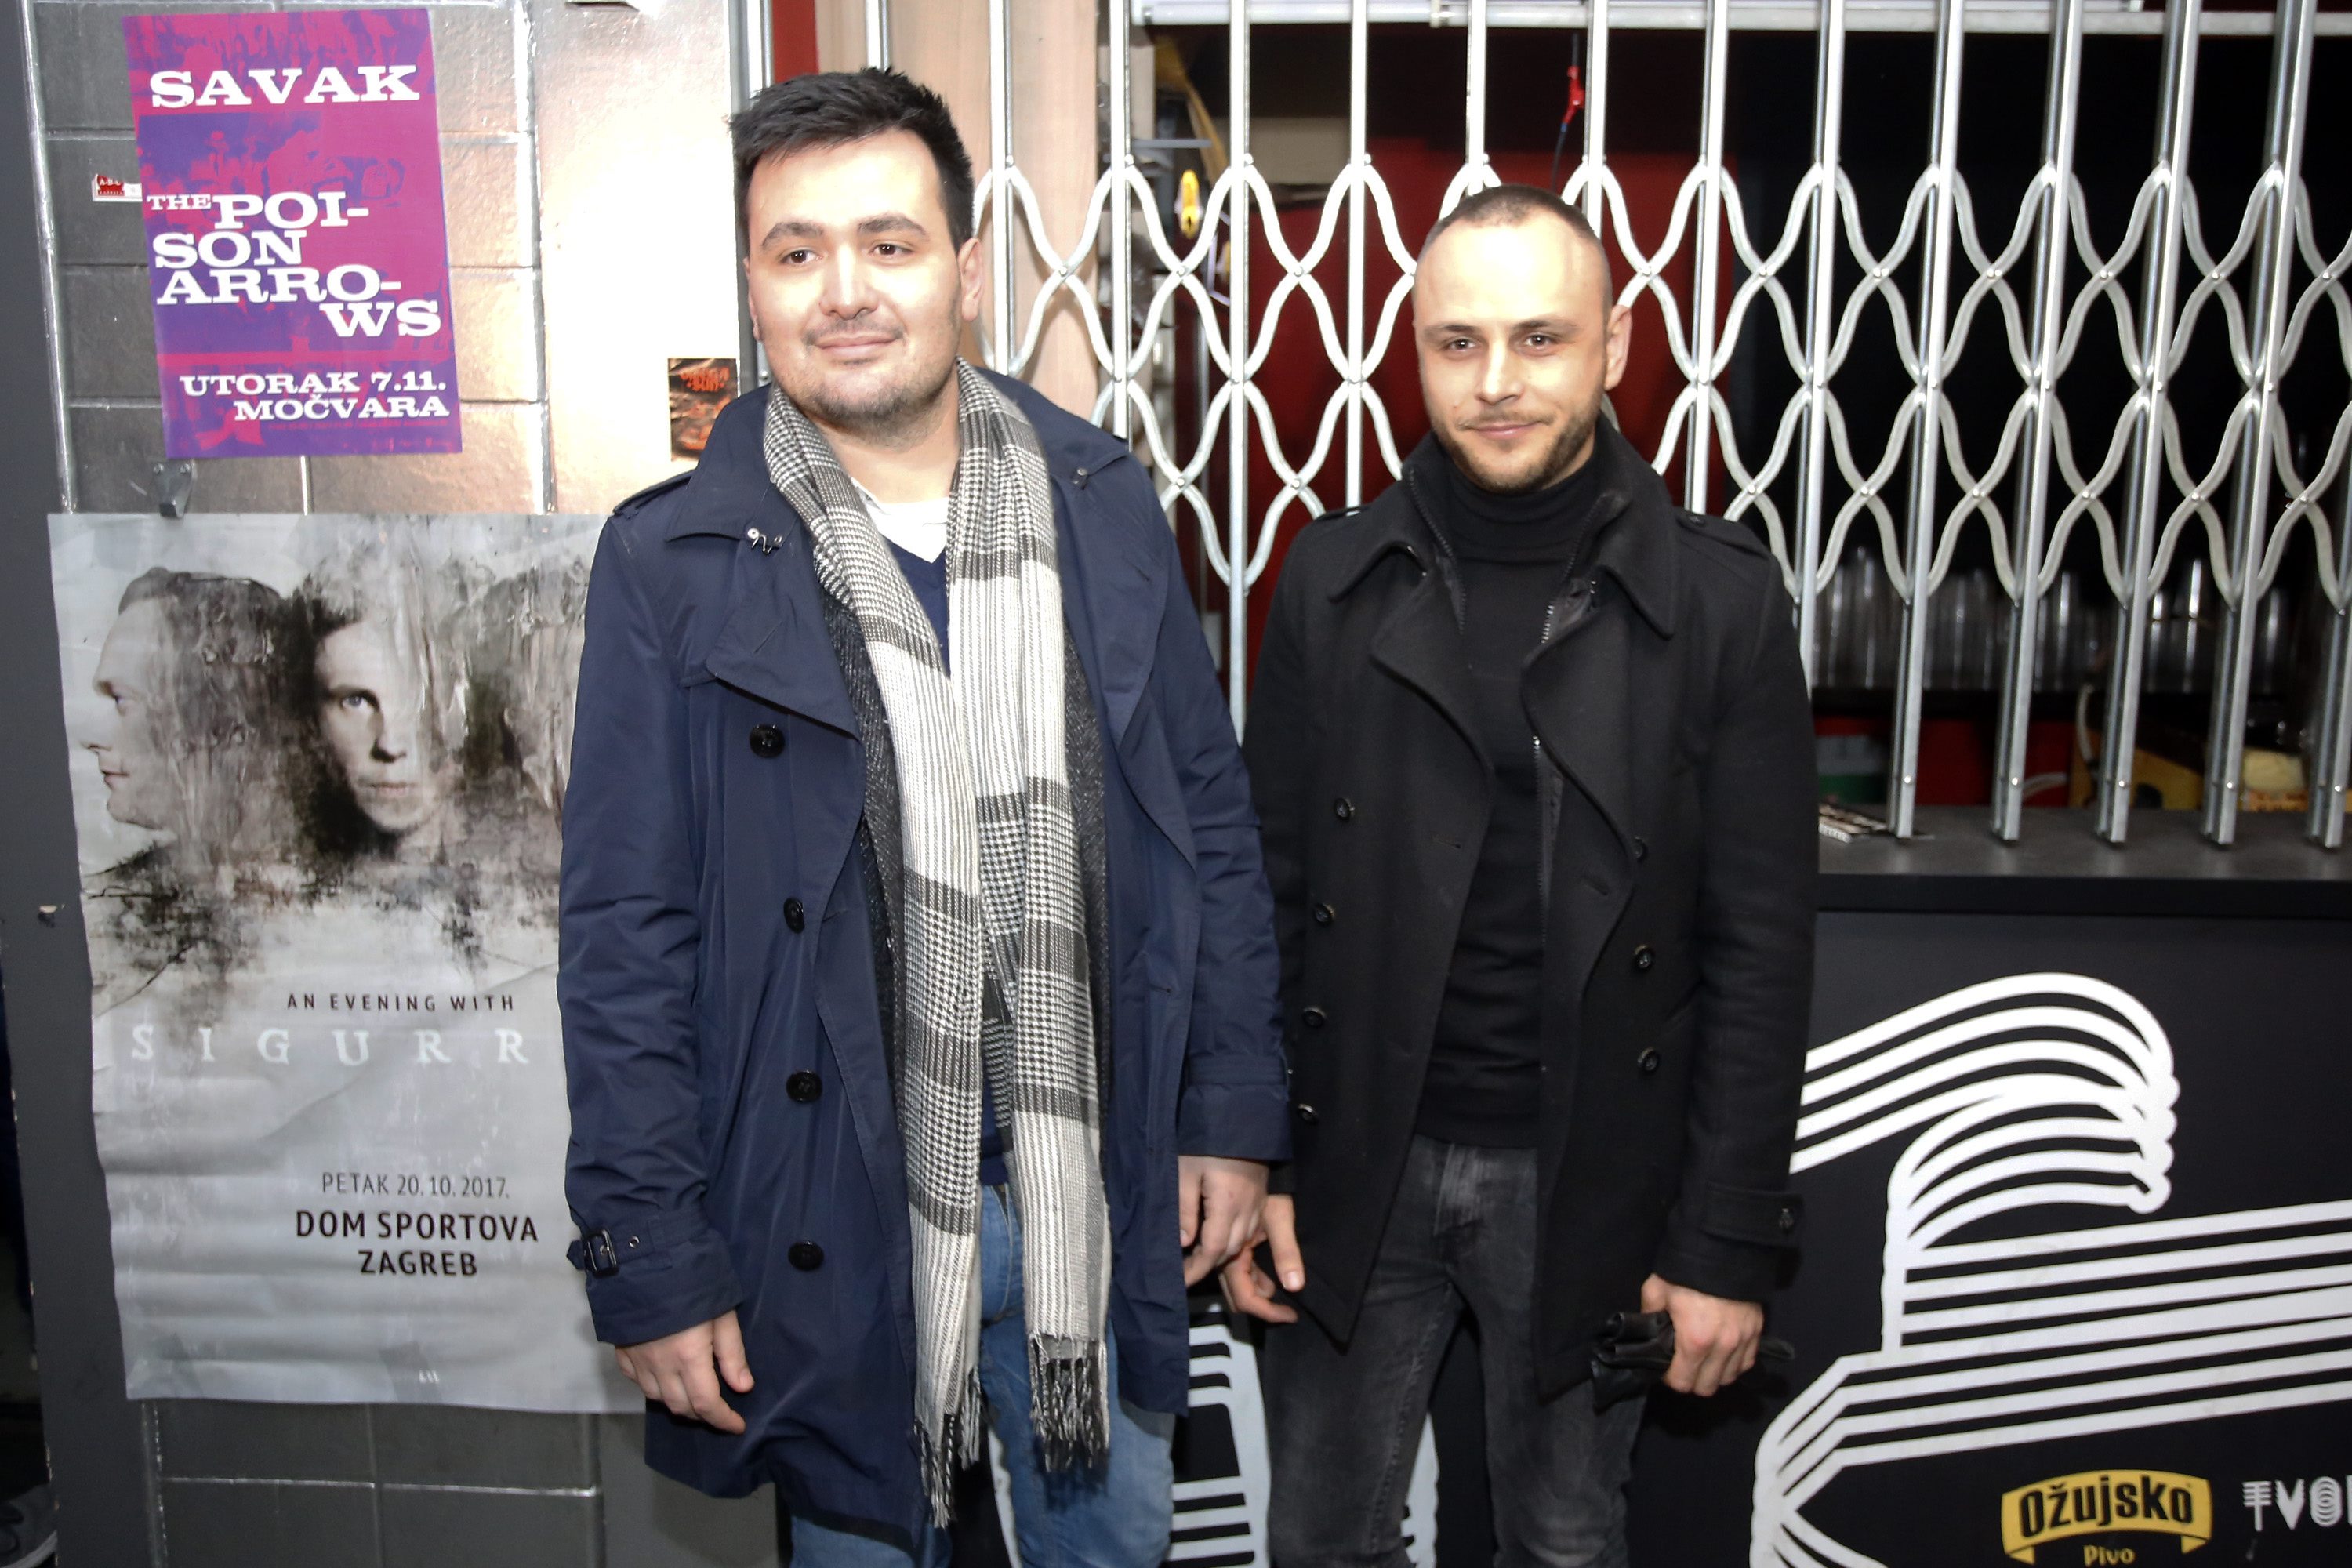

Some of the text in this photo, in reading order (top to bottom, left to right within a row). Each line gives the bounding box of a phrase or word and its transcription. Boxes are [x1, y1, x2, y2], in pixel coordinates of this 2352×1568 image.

[150, 65, 420, 108] SAVAK
[146, 191, 369, 229] THE POI-
[152, 230, 307, 268] SON
[156, 264, 401, 305] ARRO-
[318, 299, 441, 337] WS
[179, 370, 447, 396] UTORAK 7.11.
[233, 394, 450, 421] MOČVARA
[287, 993, 514, 1011] AN EVENING WITH
[322, 1172, 390, 1196] PETAK
[296, 1211, 539, 1243] DOM SPORTOVA
[358, 1250, 477, 1276] ZAGREB
[2019, 1474, 2194, 1538] Ožujsko
[2241, 1475, 2352, 1532] TVO
